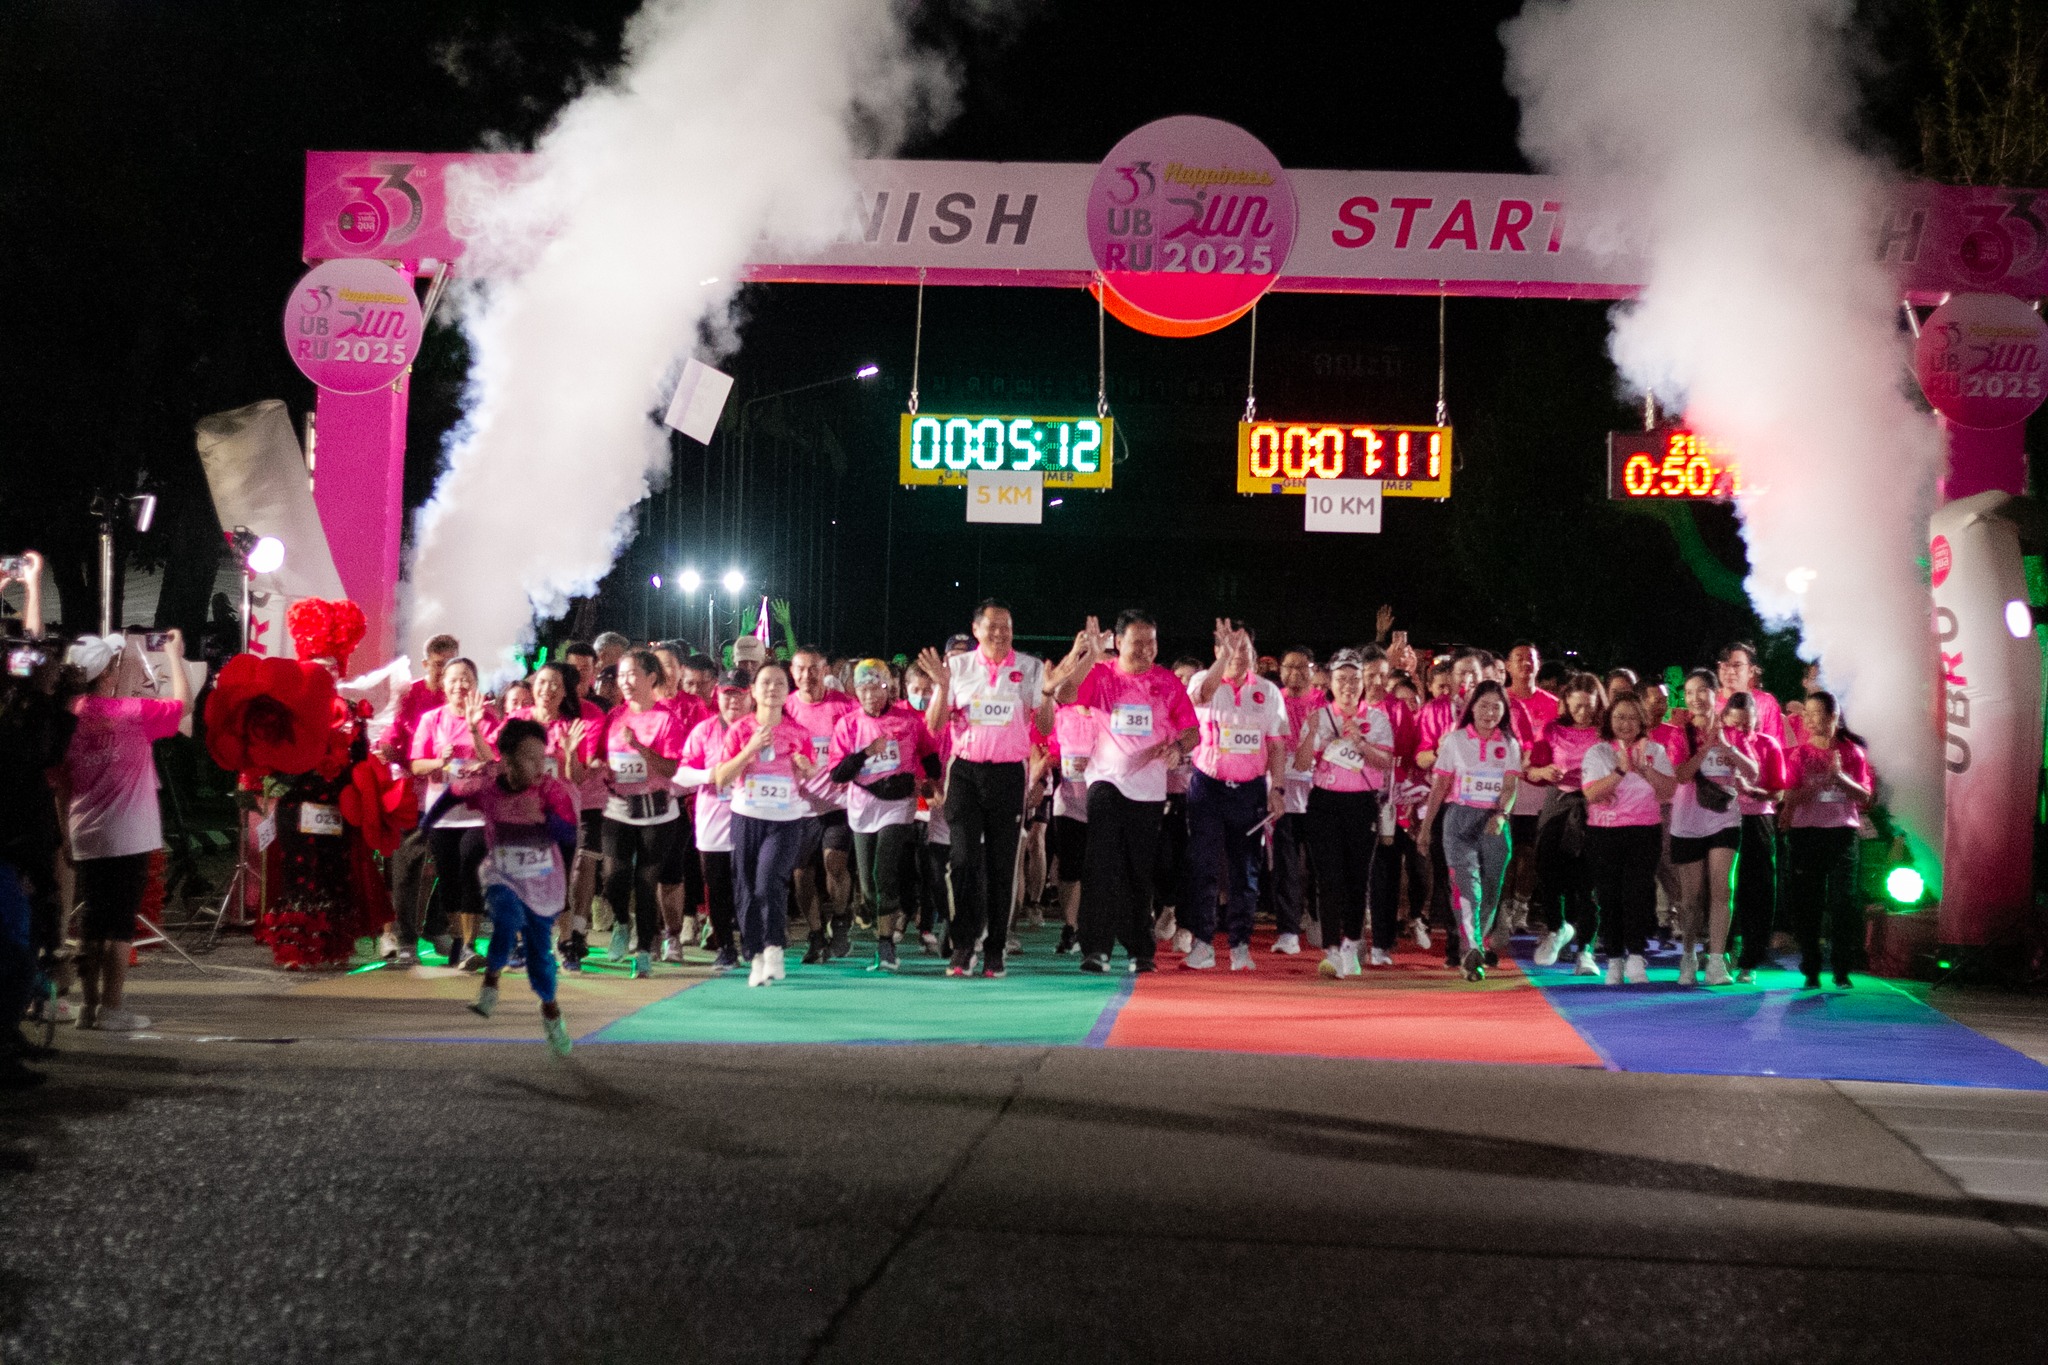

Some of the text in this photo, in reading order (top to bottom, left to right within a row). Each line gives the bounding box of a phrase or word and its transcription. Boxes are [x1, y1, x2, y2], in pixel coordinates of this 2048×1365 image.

[1107, 208, 1153, 237] UB
[1105, 243, 1152, 271] RU
[1163, 242, 1273, 275] 2025
[300, 316, 329, 336] UB
[298, 339, 329, 360] RU
[335, 341, 407, 365] 2025
[1967, 376, 2042, 398] 2025
[912, 417, 1101, 472] 00:05:12
[1250, 425, 1441, 479] 00:07:11
[977, 485, 1032, 505] 5 KM
[1311, 496, 1375, 515] 10 KM
[1126, 715, 1149, 725] 381
[1234, 734, 1259, 745] 006
[620, 763, 643, 774] 512
[761, 785, 788, 798] 523
[1475, 781, 1501, 792] 846
